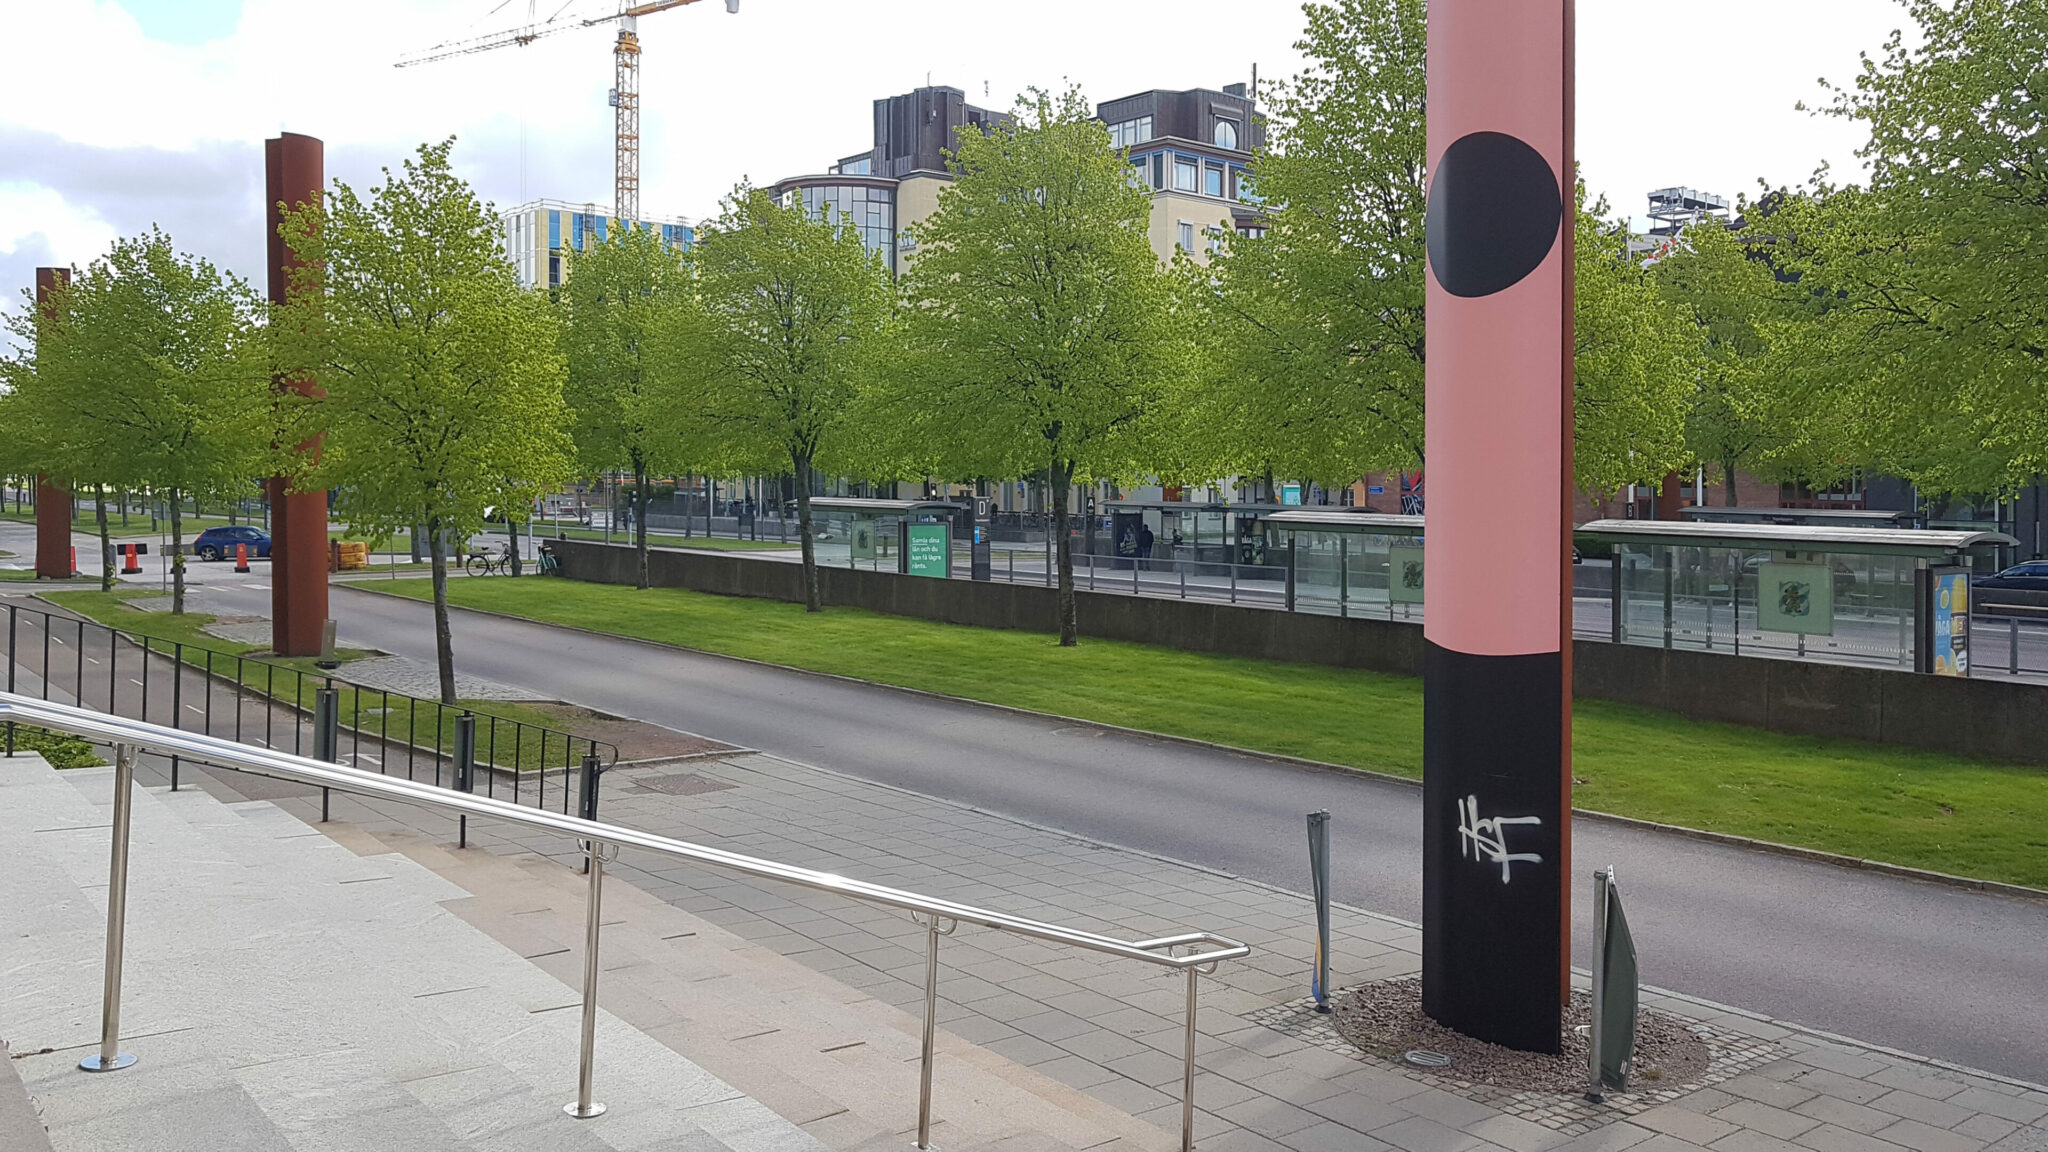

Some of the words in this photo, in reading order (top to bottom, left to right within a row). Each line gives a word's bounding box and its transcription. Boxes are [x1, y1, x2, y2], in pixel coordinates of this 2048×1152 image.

[1088, 499, 1094, 507] A
[979, 501, 986, 515] D
[928, 554, 942, 562] lägre
